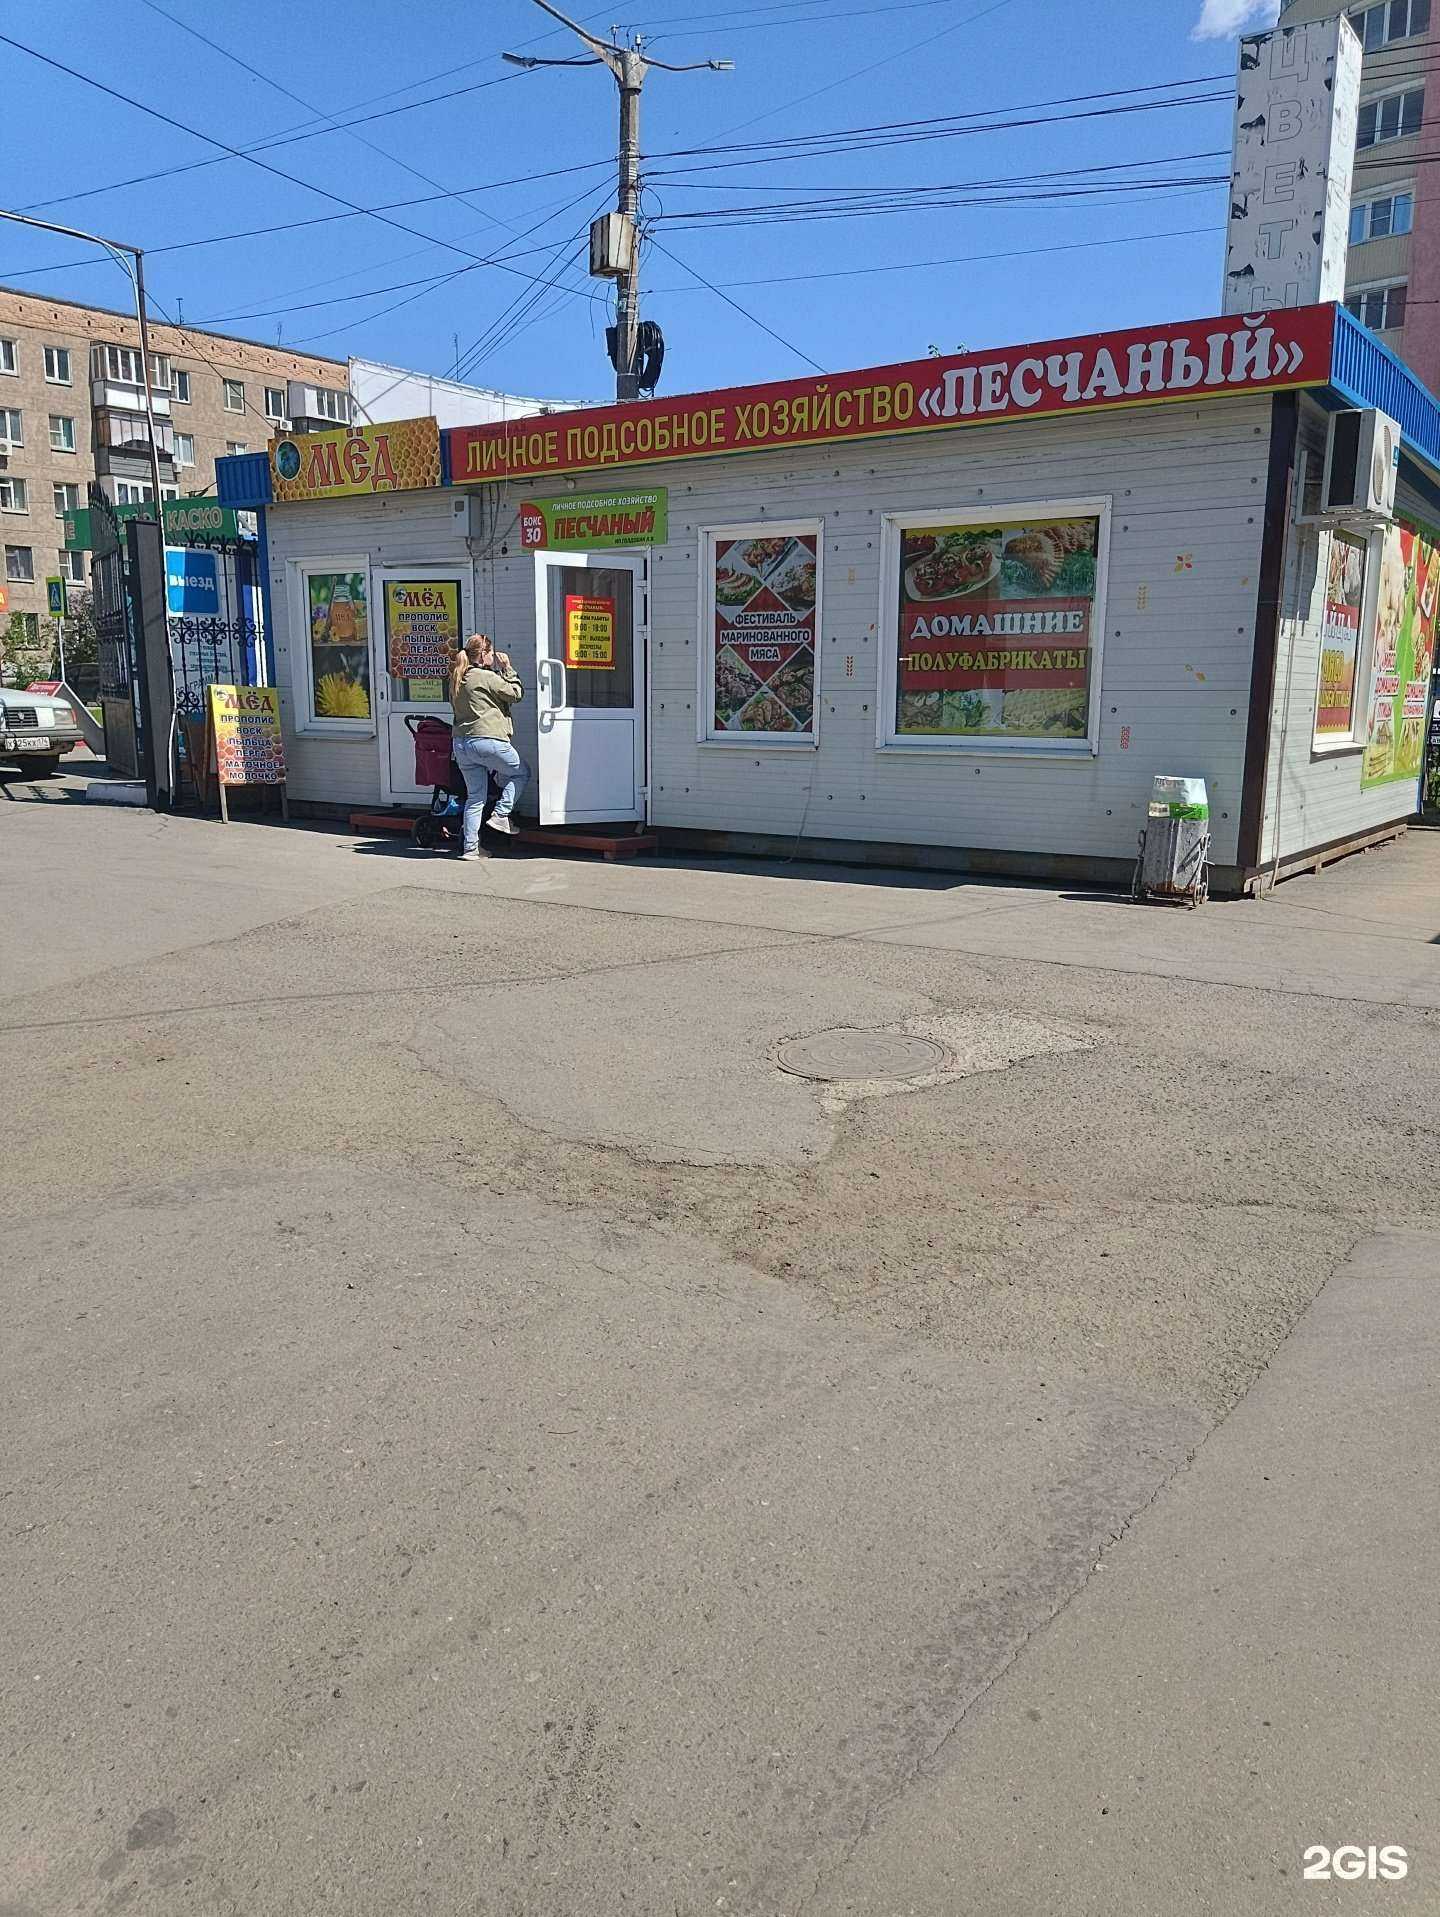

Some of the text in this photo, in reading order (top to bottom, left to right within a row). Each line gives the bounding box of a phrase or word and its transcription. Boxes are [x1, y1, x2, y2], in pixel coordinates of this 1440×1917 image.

[466, 313, 1305, 473] ЛИЧНОЕ ПОДСОБНОЕ ХОЗЯЙСТВО «ПЕСЧАНЫЙ»
[306, 427, 399, 492] МЁД
[551, 495, 658, 511] ЛИЧНОЕ ПОДСОБНОЕ ХОЗЯЙСТВО
[166, 506, 223, 531] КАСКО
[523, 515, 543, 527] БОКС
[553, 506, 656, 540] ПЕСЧАНЫЙ
[525, 528, 541, 544] 30
[403, 588, 446, 610] МЁД
[398, 613, 448, 621] ПРОПОЛИС
[735, 612, 796, 625] ФЕСТИВАЛЬ
[412, 624, 436, 632] ВОСК
[910, 610, 1085, 640] ДОМАШНИЕ
[404, 636, 444, 644] ПЫЛЬЦА
[721, 630, 810, 643] МАРИНОВАННОГО
[410, 646, 439, 654] ПЕРГА
[750, 649, 780, 660] МЯСА
[400, 656, 449, 665] МАТОЧНОЕ
[907, 647, 1087, 671] ПОЛУФАБРИКАТЫ
[403, 667, 447, 675] МОЛОЧКО
[224, 691, 274, 714] МЁД
[221, 715, 274, 724] ПРОПОЛИС
[236, 727, 262, 735] ВОСК
[229, 738, 272, 747] ПЫЛЬЦА
[236, 749, 267, 757] ПЕРГА
[225, 761, 280, 769] МАТОЧНОЕ
[229, 772, 278, 780] МОЛОЧКО
